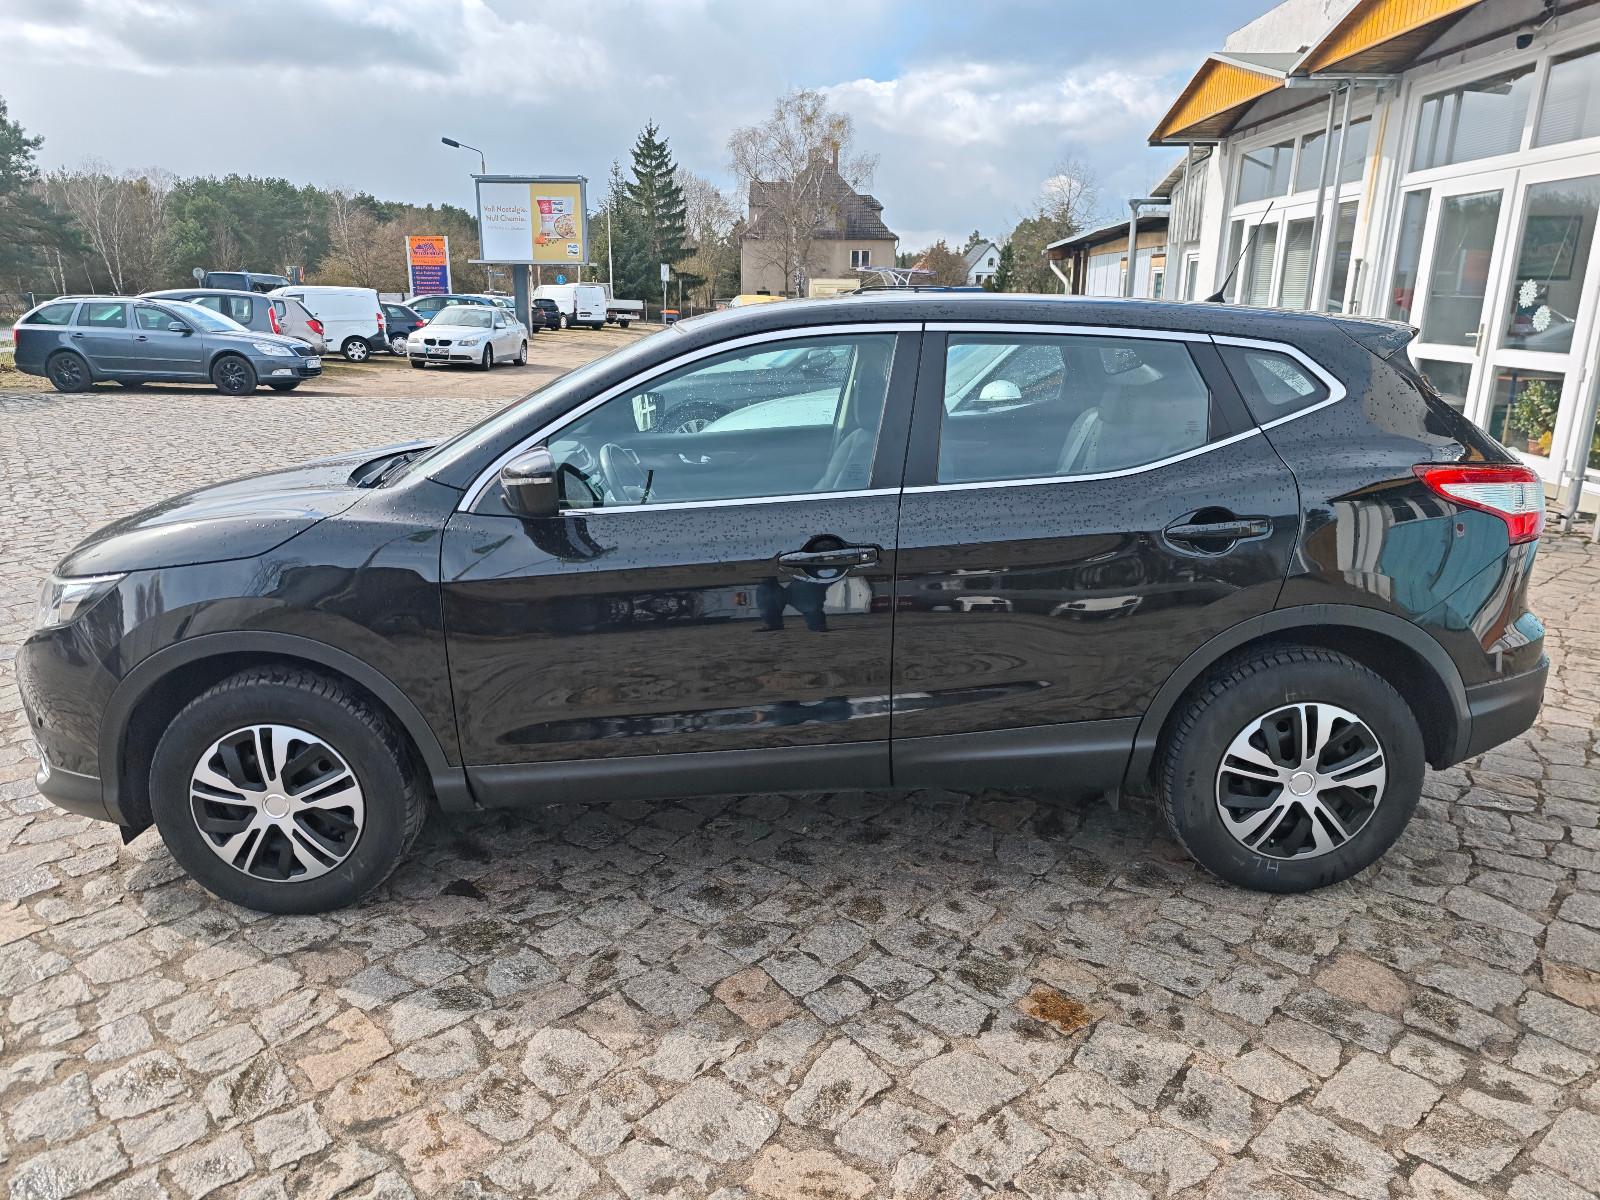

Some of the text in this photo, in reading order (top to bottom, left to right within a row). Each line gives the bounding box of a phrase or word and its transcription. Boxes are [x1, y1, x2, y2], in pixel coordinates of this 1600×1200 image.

[484, 204, 528, 214] Voll Nostalgie.
[486, 214, 499, 222] Null
